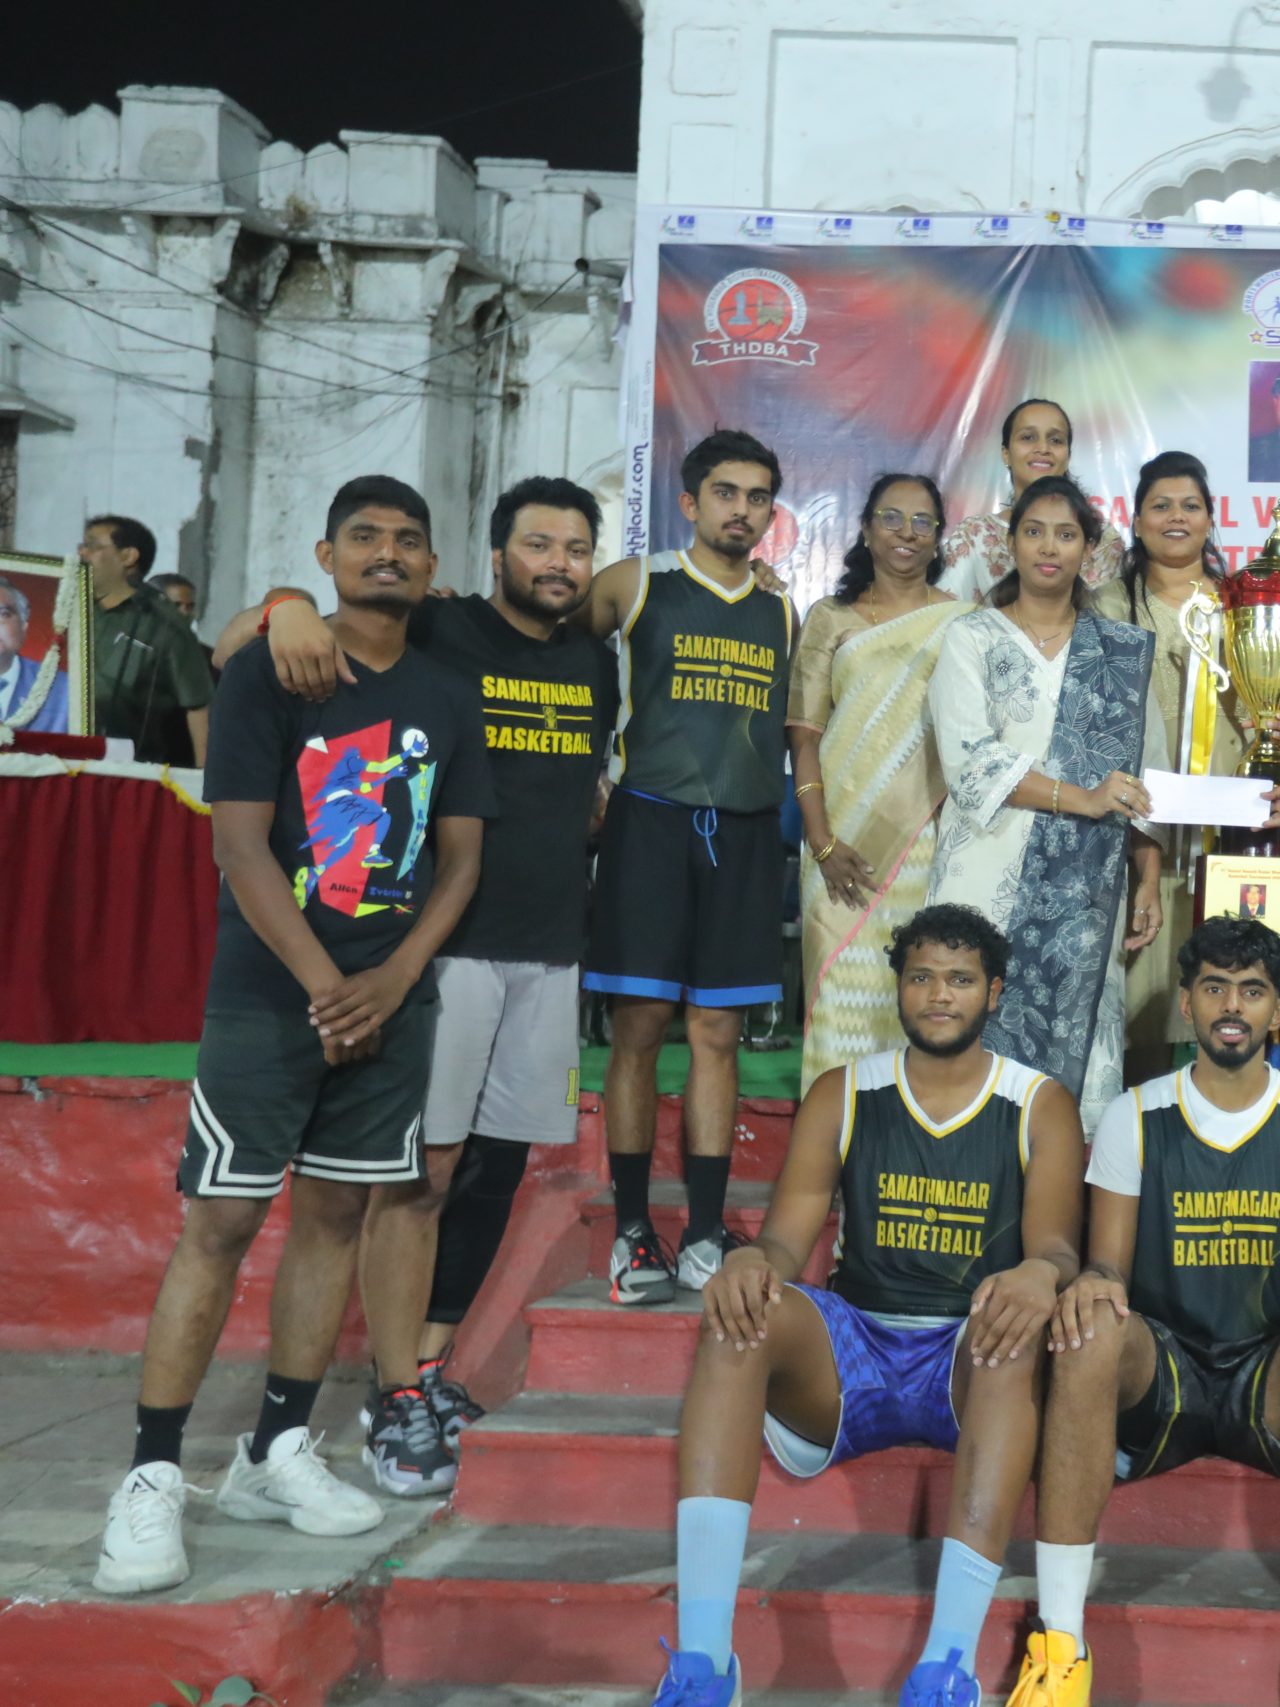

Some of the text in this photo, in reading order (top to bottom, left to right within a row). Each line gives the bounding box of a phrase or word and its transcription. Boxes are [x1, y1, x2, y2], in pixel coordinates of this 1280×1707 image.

[719, 341, 789, 357] THDBA
[674, 633, 776, 672] SANATHNAGAR
[482, 675, 594, 707] SANATHNAGAR
[671, 676, 770, 712] BASKETBALL
[484, 725, 592, 755] BASKETBALL
[878, 1172, 990, 1209] SANATHNAGAR
[876, 1220, 983, 1257] BASKETBALL
[1173, 1238, 1275, 1267] BASKETBALL
